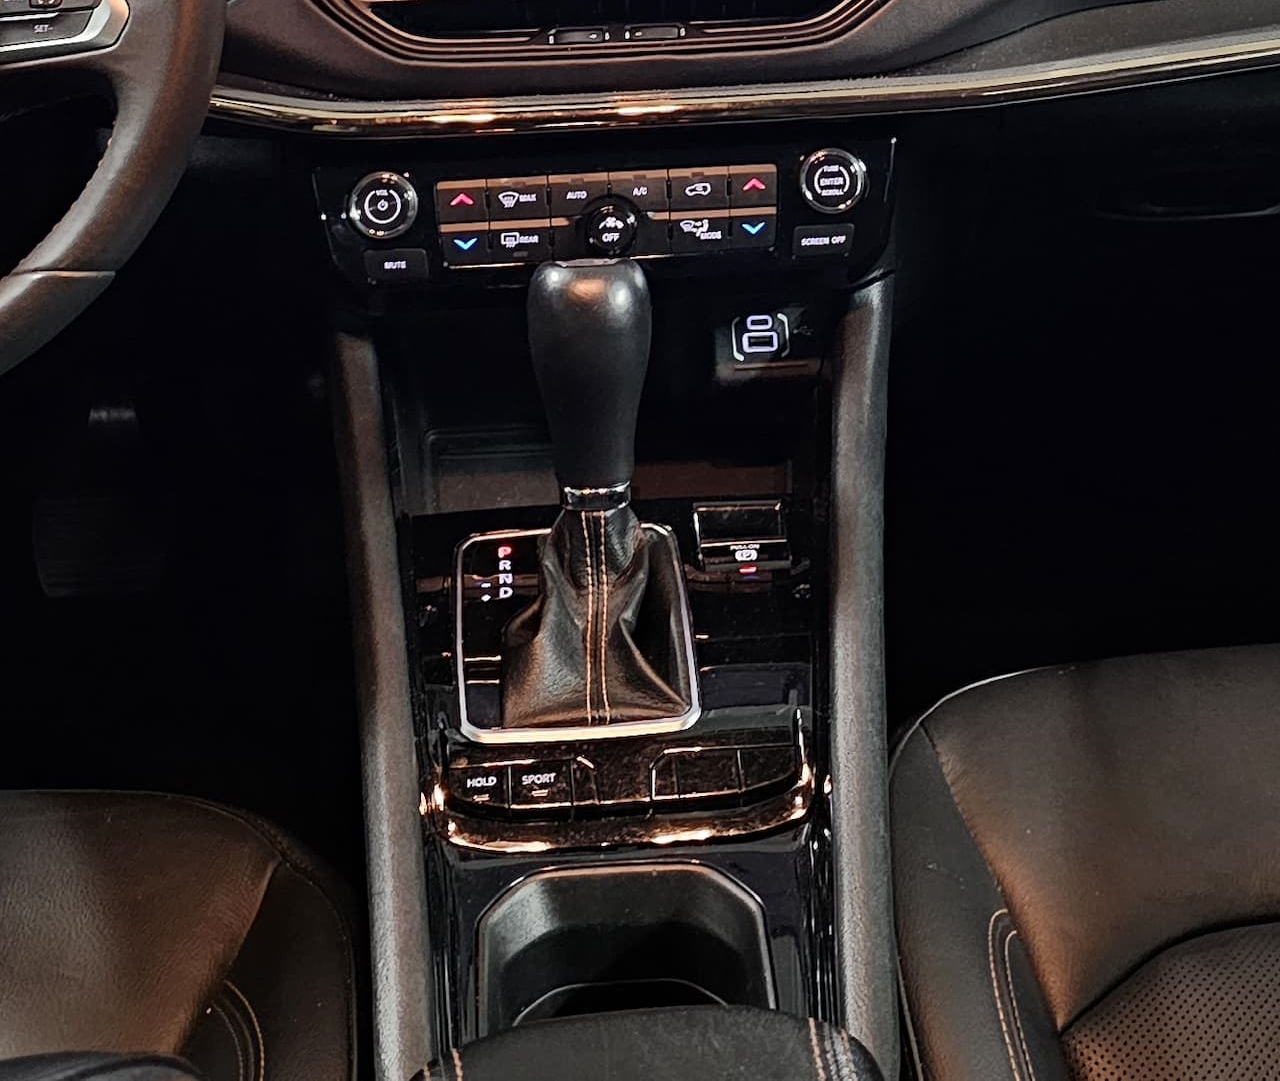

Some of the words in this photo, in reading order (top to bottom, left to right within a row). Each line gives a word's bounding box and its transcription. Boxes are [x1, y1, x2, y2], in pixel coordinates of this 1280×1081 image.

[566, 190, 588, 200] AUTO
[632, 186, 648, 196] A/C
[601, 232, 620, 242] OFF
[801, 236, 830, 246] SCREEN
[831, 235, 847, 244] OFF
[383, 260, 407, 269] MUTE
[497, 546, 512, 559] P
[499, 560, 512, 571] R
[499, 586, 514, 599] D
[466, 776, 497, 788] HOLD
[521, 772, 557, 785] SPORT
